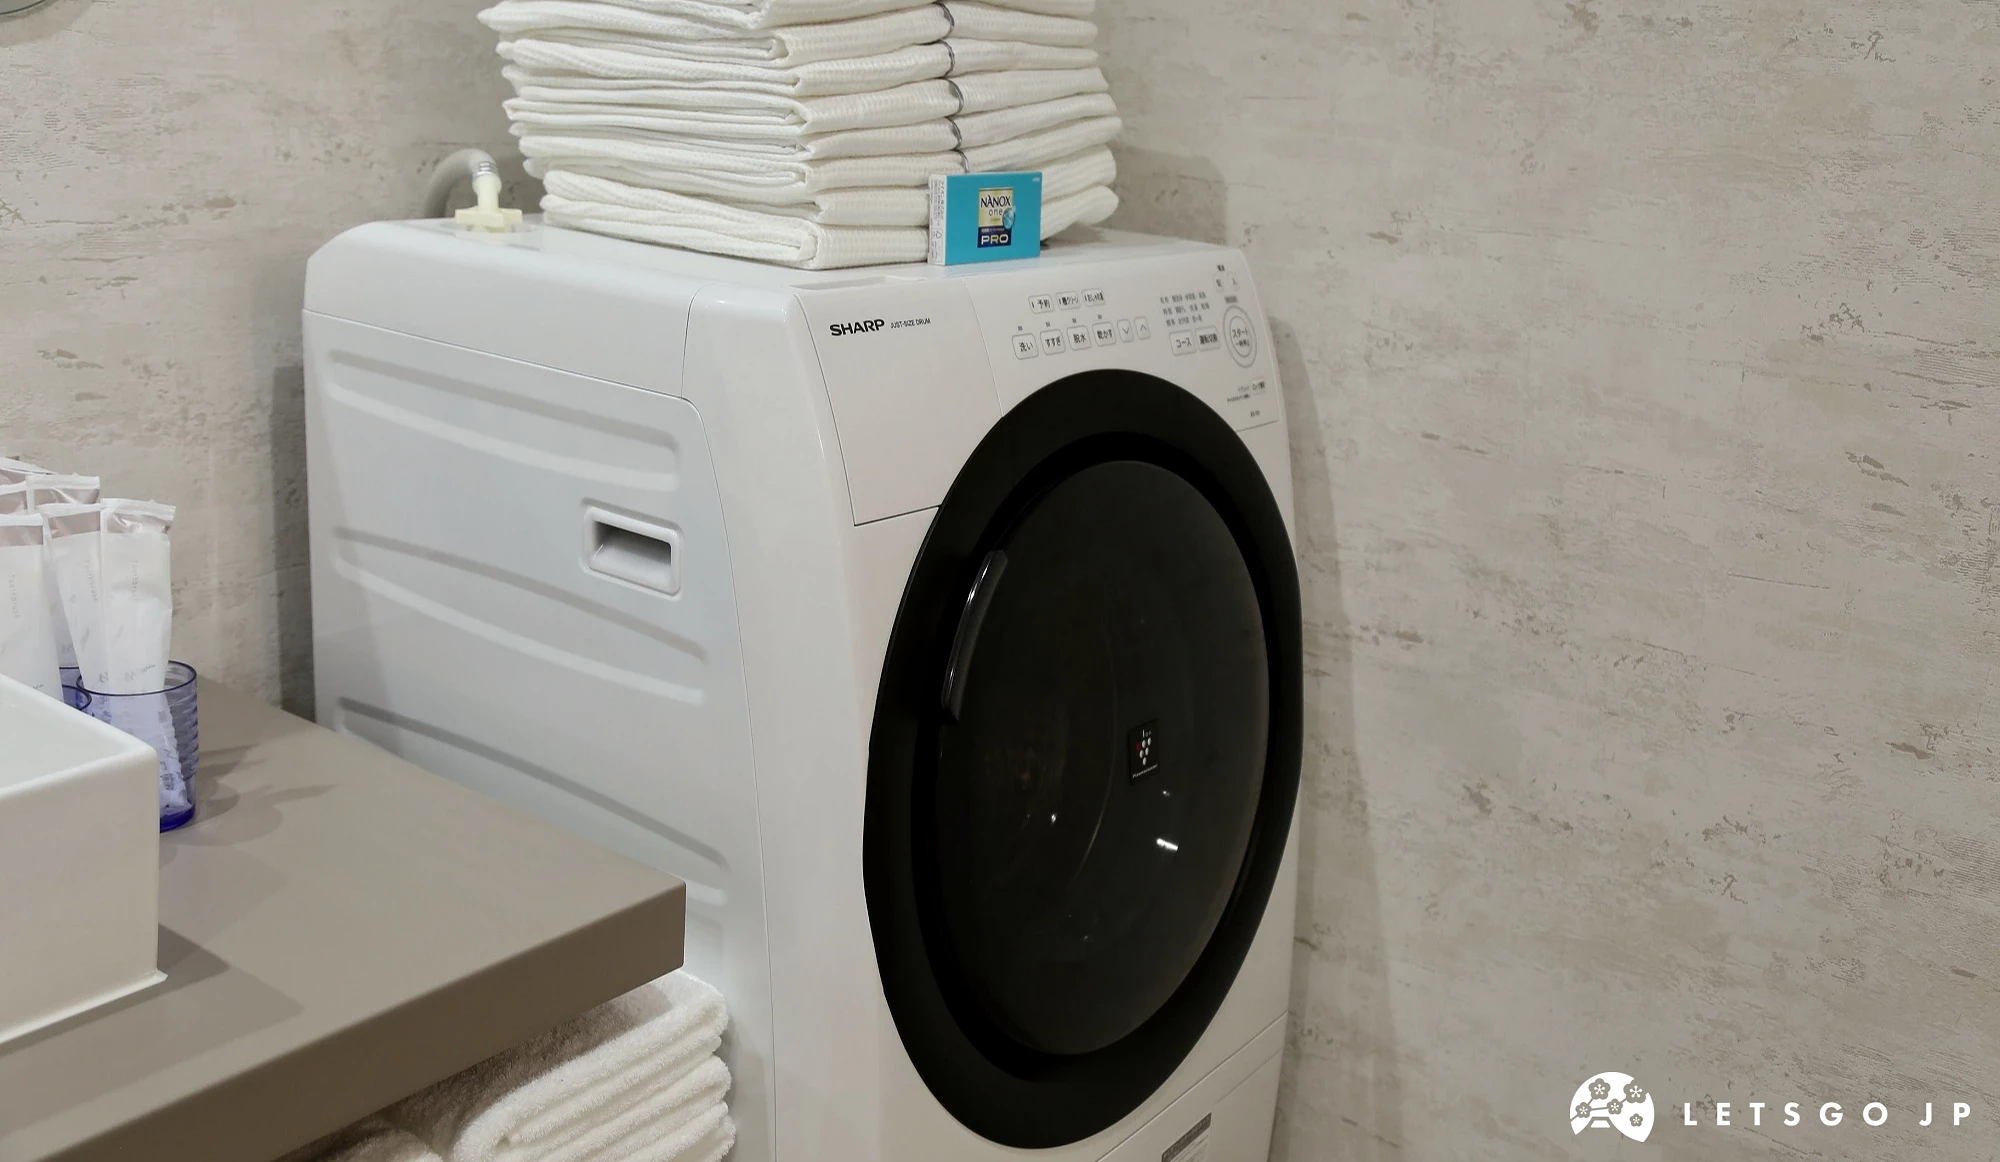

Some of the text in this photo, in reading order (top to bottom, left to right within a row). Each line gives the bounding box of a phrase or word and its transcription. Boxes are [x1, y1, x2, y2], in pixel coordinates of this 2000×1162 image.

[980, 194, 1011, 209] NANOX
[988, 208, 1003, 216] one
[981, 233, 1009, 245] PRO
[829, 318, 885, 337] SHARP
[915, 317, 931, 326] DRUM
[1073, 332, 1087, 344] 脱水
[1231, 329, 1249, 338] スタート
[1019, 341, 1034, 353] 洗い
[1045, 337, 1061, 348] すすぎ
[1175, 337, 1192, 349] コース
